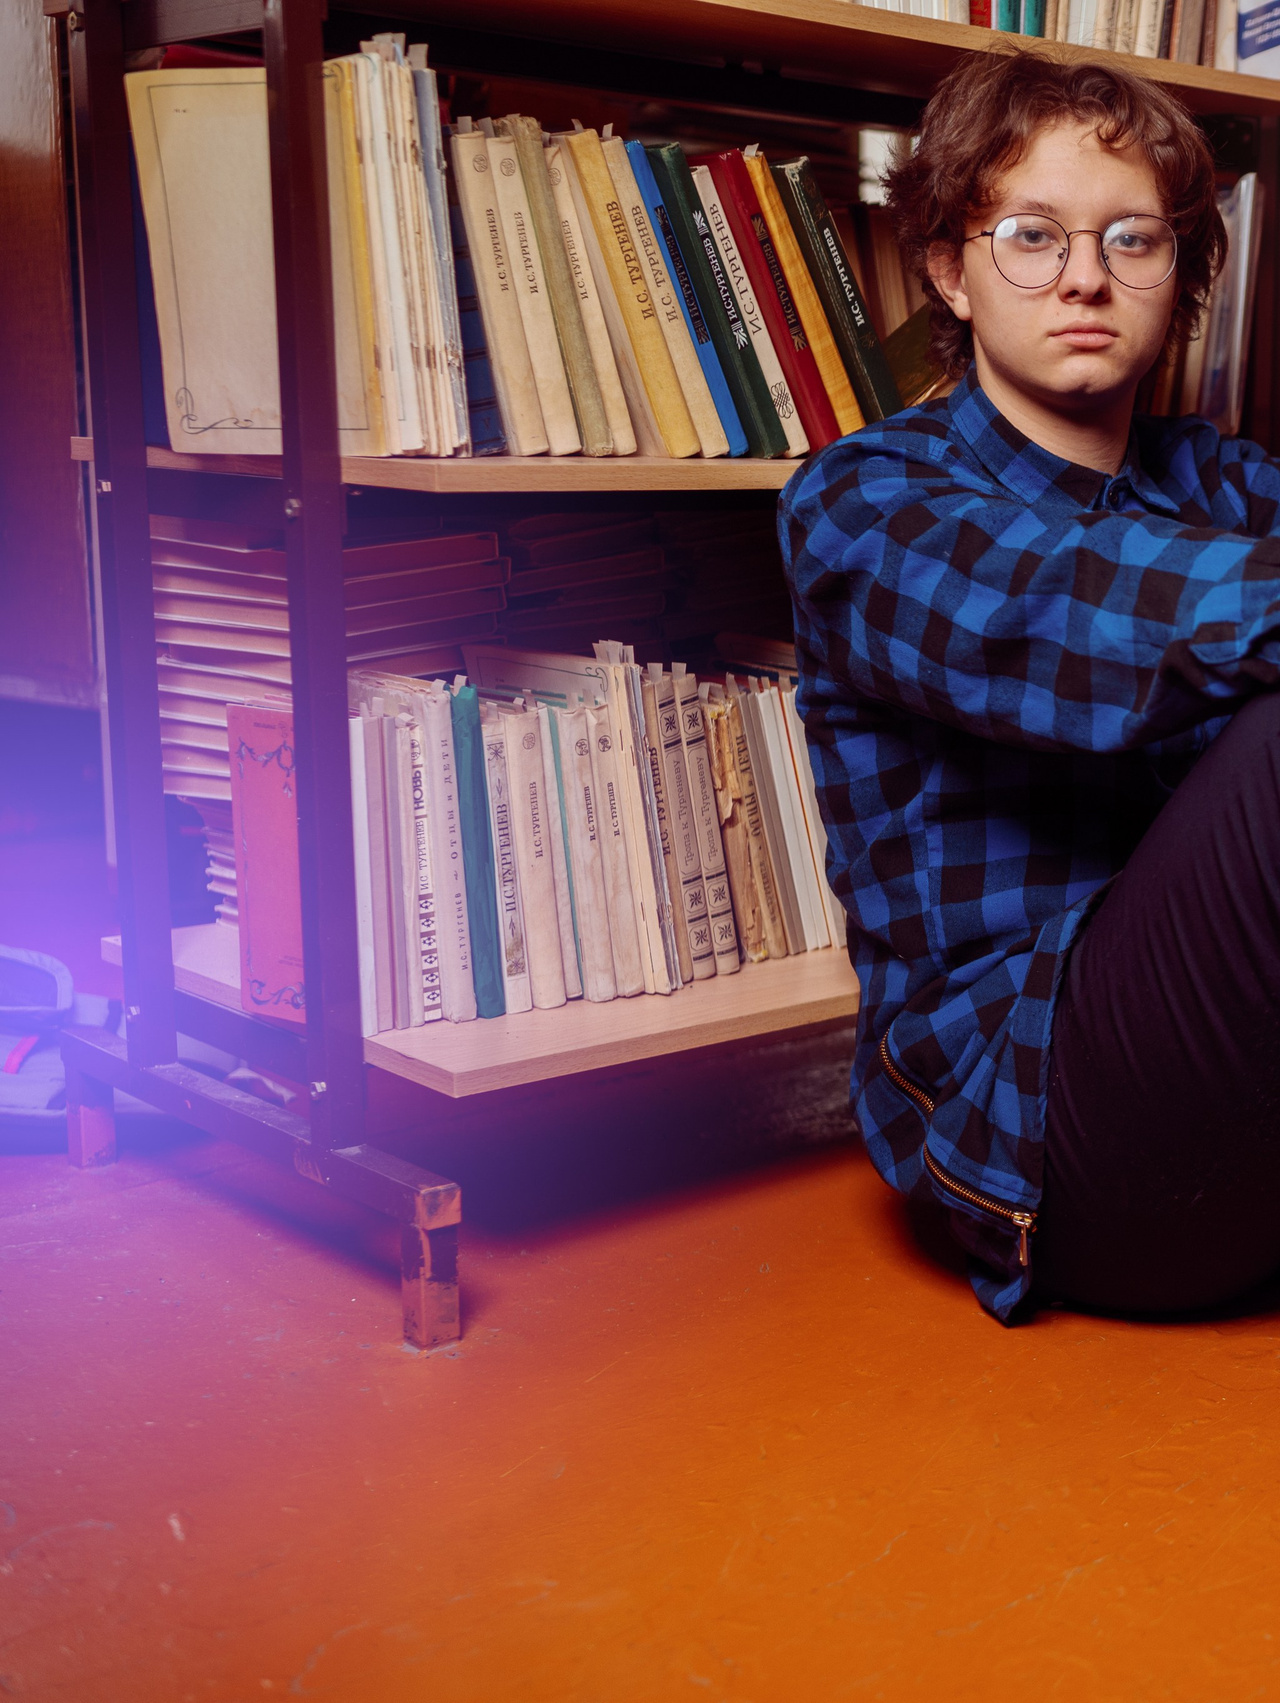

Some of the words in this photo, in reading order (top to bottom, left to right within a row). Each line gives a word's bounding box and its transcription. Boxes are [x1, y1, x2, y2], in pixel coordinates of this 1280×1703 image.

[485, 208, 505, 269] ТУРГЕНЕВ
[514, 211, 533, 272] ТУРГЕНЕВ
[561, 220, 582, 278] ТУРГЕНЕВ
[606, 200, 643, 285] ТУРГЕНЕВ
[631, 204, 666, 288] ТУРГЕНЕВ
[709, 203, 749, 300] ТУРГЕНЕВ
[823, 227, 855, 302] ТУРГЕНЕВ
[440, 739, 452, 784] ДЕТИ
[648, 747, 666, 821] ТУРГЕНЕВ
[673, 760, 688, 820] Тургеневу
[697, 756, 710, 817] Тургеневу
[412, 770, 424, 811] НОВЬ
[529, 781, 541, 837] ТУРГЕНЕВ
[583, 786, 594, 825] ТУРГЕНЕВ
[607, 781, 617, 820] ТУРГЕНЕВ
[744, 793, 761, 837] ОТЦЫ
[415, 820, 428, 871] ТУРГЕНЕВ
[447, 810, 458, 860] ОТЦЫ
[684, 833, 695, 866] Тропа
[706, 828, 718, 862] Тропа
[454, 892, 466, 949] ТУРГЕНЕВ
